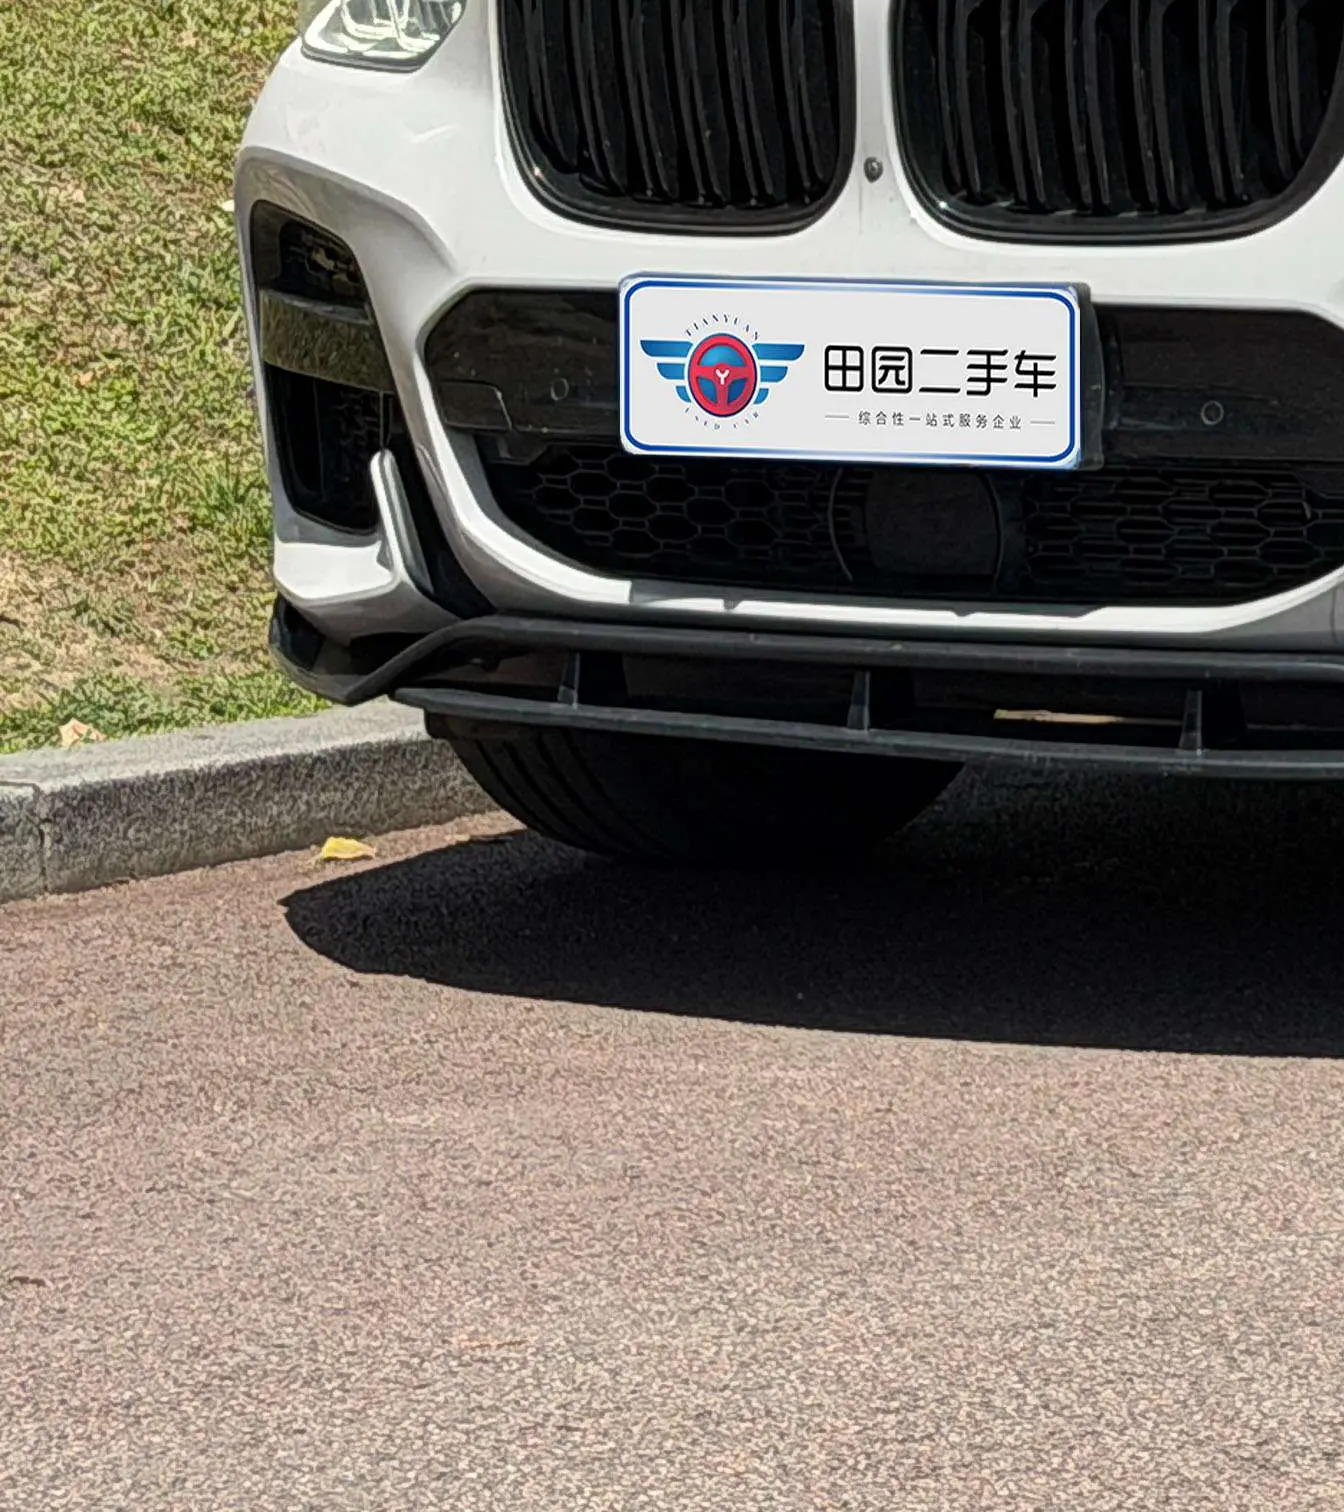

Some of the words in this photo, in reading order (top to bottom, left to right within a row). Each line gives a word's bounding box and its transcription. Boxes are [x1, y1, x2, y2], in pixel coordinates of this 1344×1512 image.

[824, 345, 1056, 398] 田园二手车
[857, 409, 1022, 430] 综合性一站式服务企业
